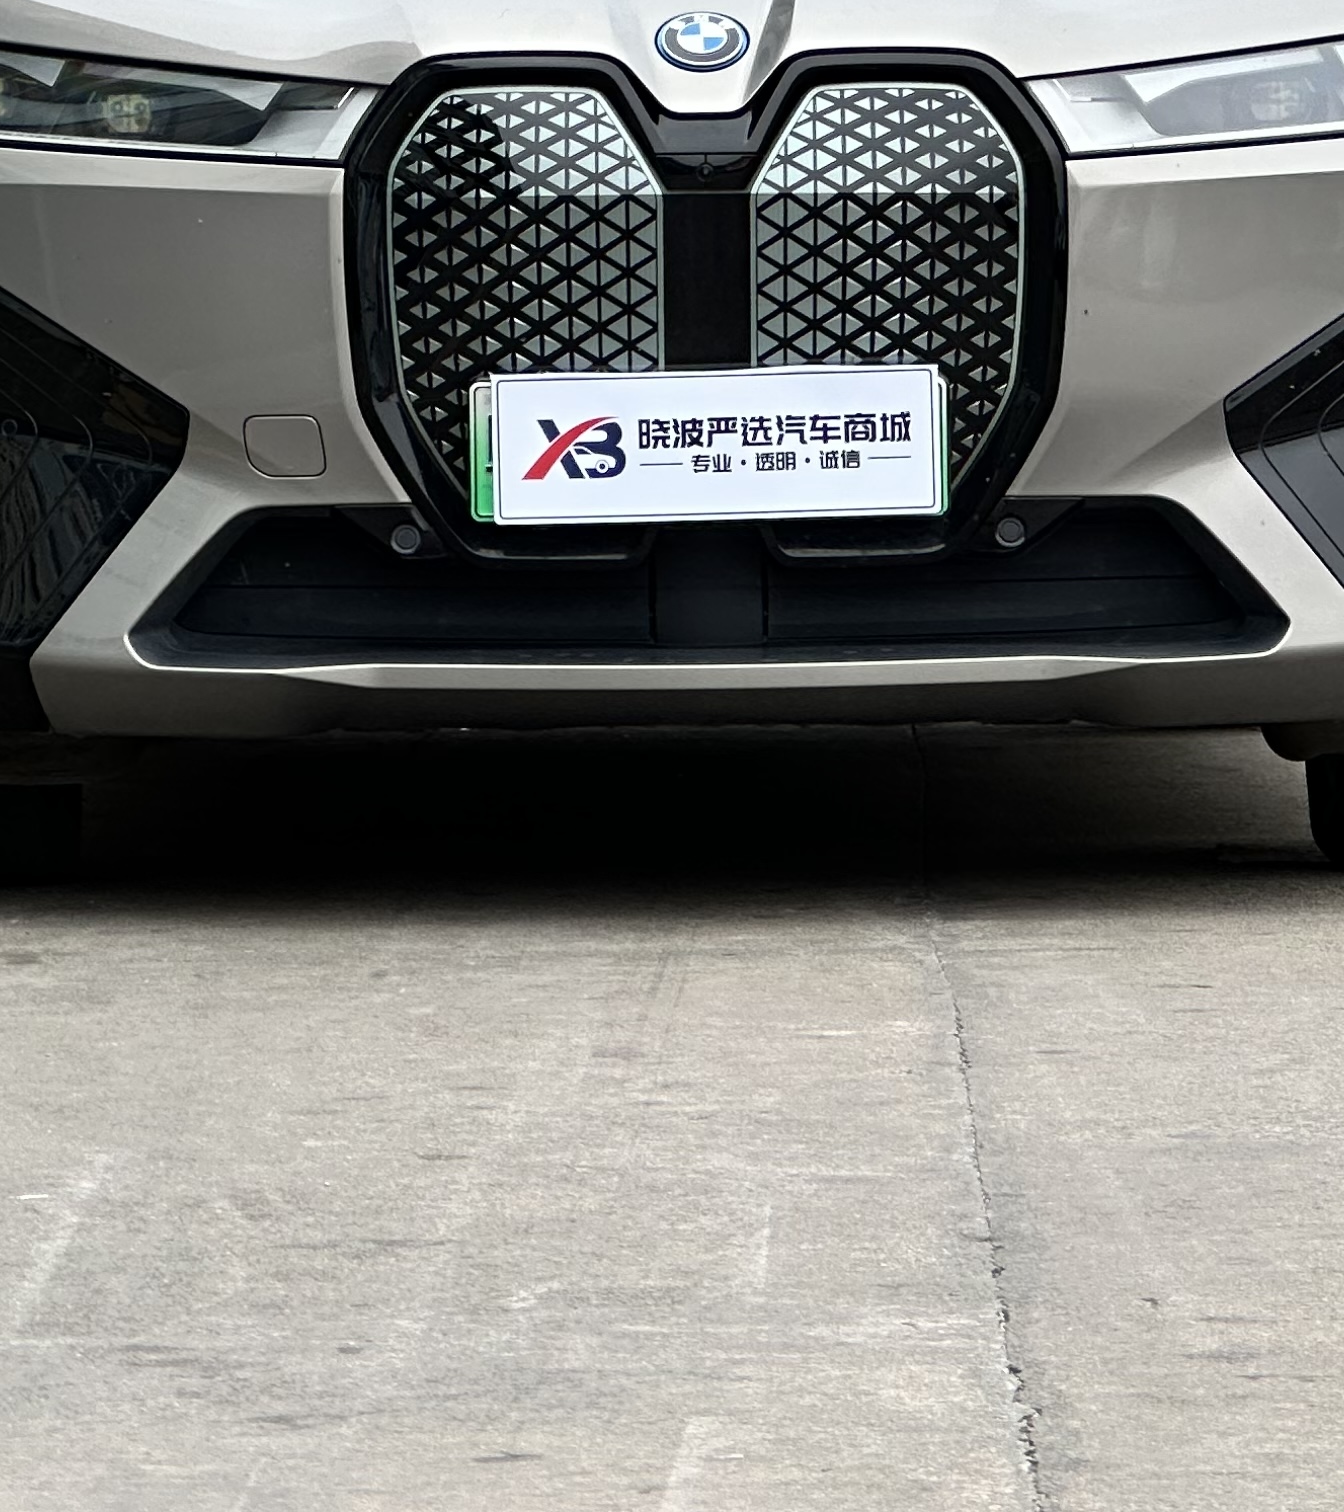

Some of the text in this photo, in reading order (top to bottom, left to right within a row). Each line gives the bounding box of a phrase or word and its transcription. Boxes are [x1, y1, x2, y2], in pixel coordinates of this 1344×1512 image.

[637, 411, 912, 450] 晓波严选汽车商城
